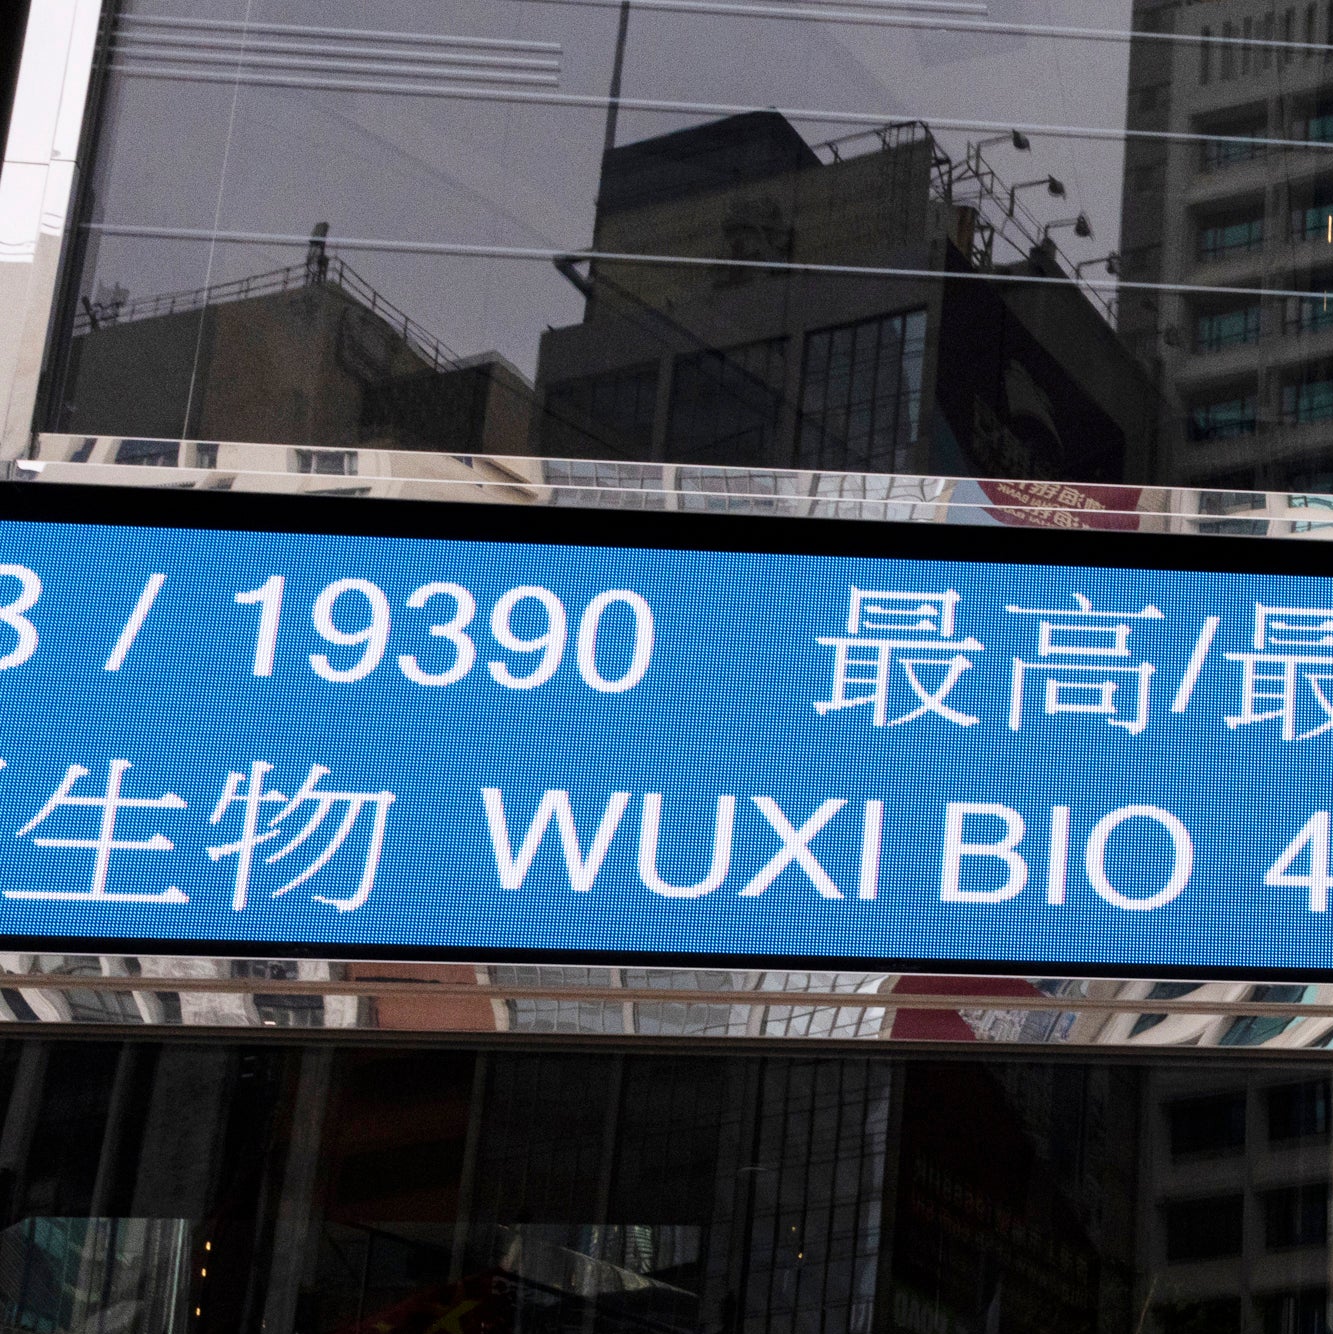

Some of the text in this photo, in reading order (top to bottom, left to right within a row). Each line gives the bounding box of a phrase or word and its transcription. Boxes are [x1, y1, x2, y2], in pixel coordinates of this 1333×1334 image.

[234, 576, 655, 695] 19390
[0, 758, 396, 915] 生物
[481, 787, 883, 902] WUXI
[939, 800, 1195, 911] BIO
